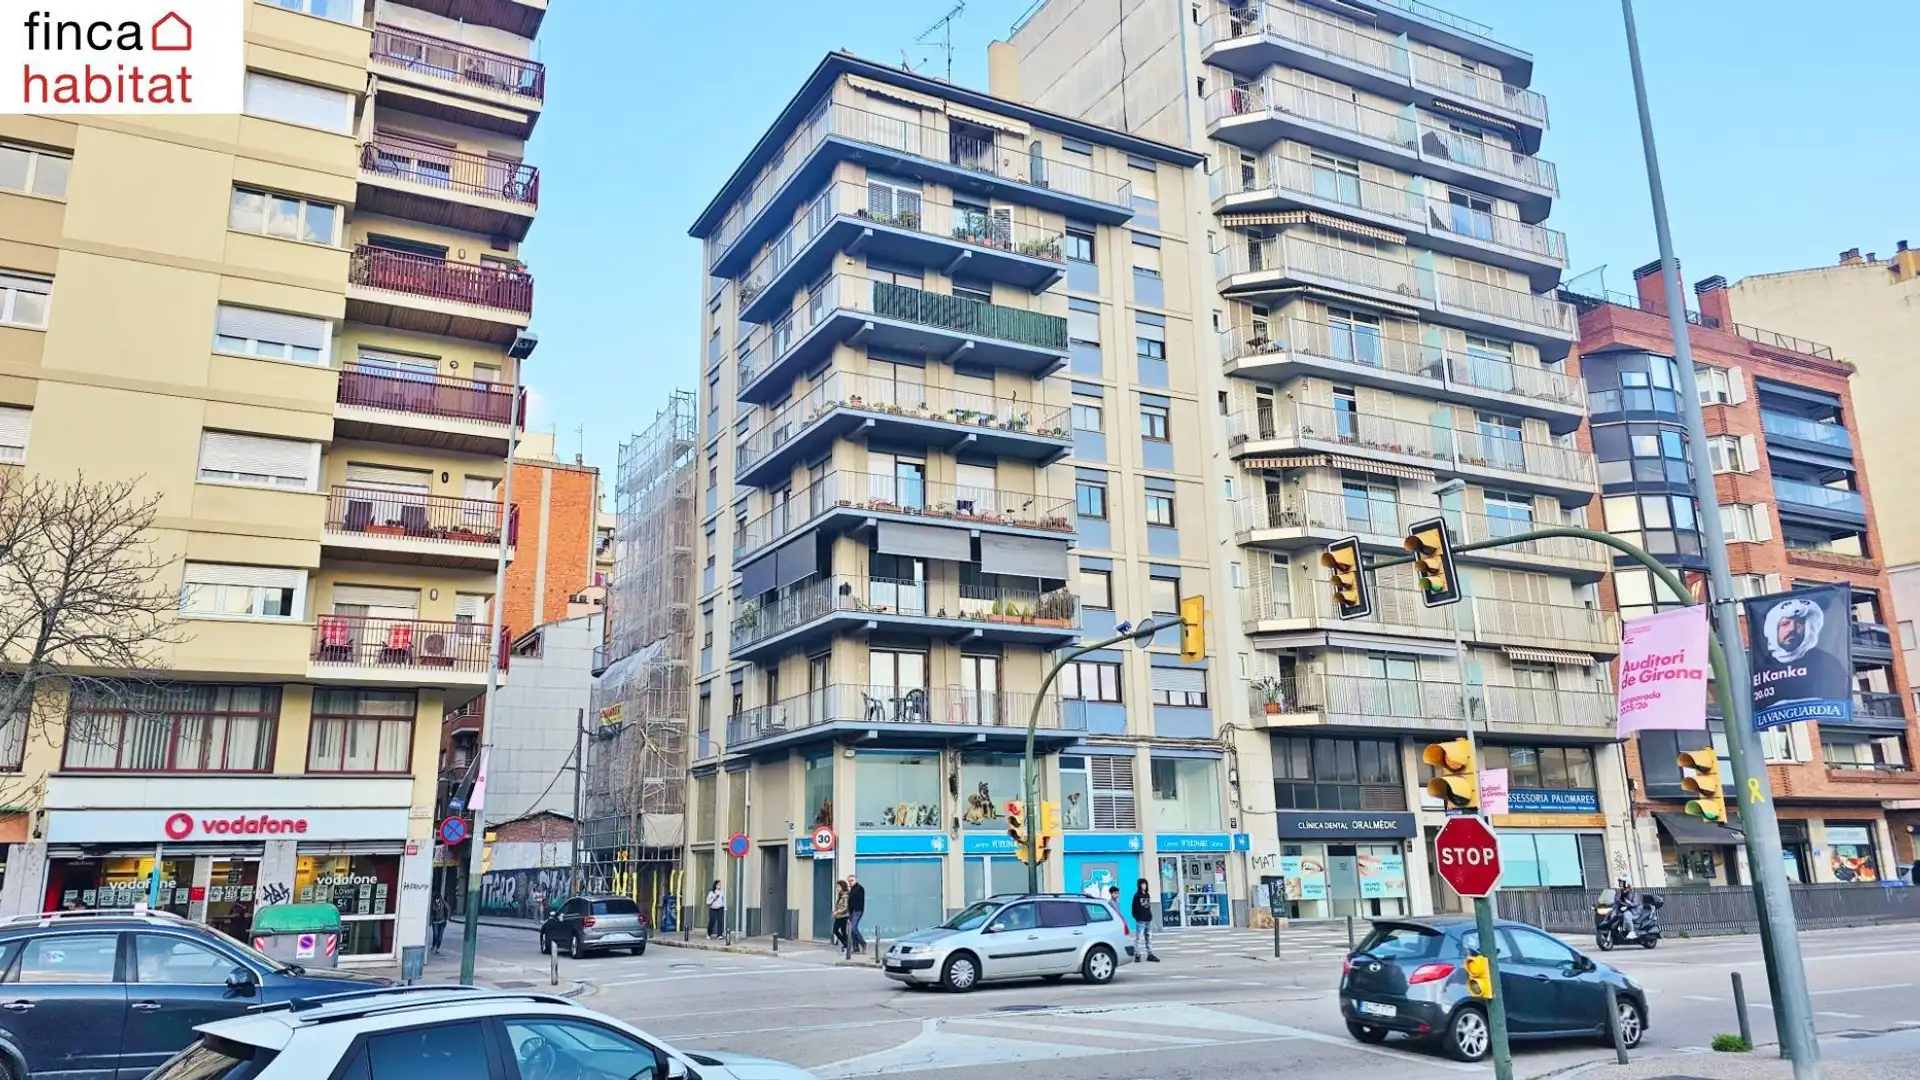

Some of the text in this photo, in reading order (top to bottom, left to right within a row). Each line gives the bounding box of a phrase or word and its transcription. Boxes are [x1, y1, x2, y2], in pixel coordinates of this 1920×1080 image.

[1622, 649, 1686, 676] Auditori
[1621, 668, 1703, 690] de Girona
[1753, 665, 1807, 686] El Kanka
[1754, 687, 1775, 700] 20.03
[1766, 705, 1841, 722] VANGUARDIA
[1508, 793, 1595, 804] SSESSORIA PALOMARES
[202, 815, 307, 834] vodafone
[1325, 821, 1348, 829] DENTAL
[817, 835, 831, 843] 30
[1442, 847, 1494, 865] STOP
[109, 878, 177, 889] vodafne
[317, 873, 377, 885] vodafone
